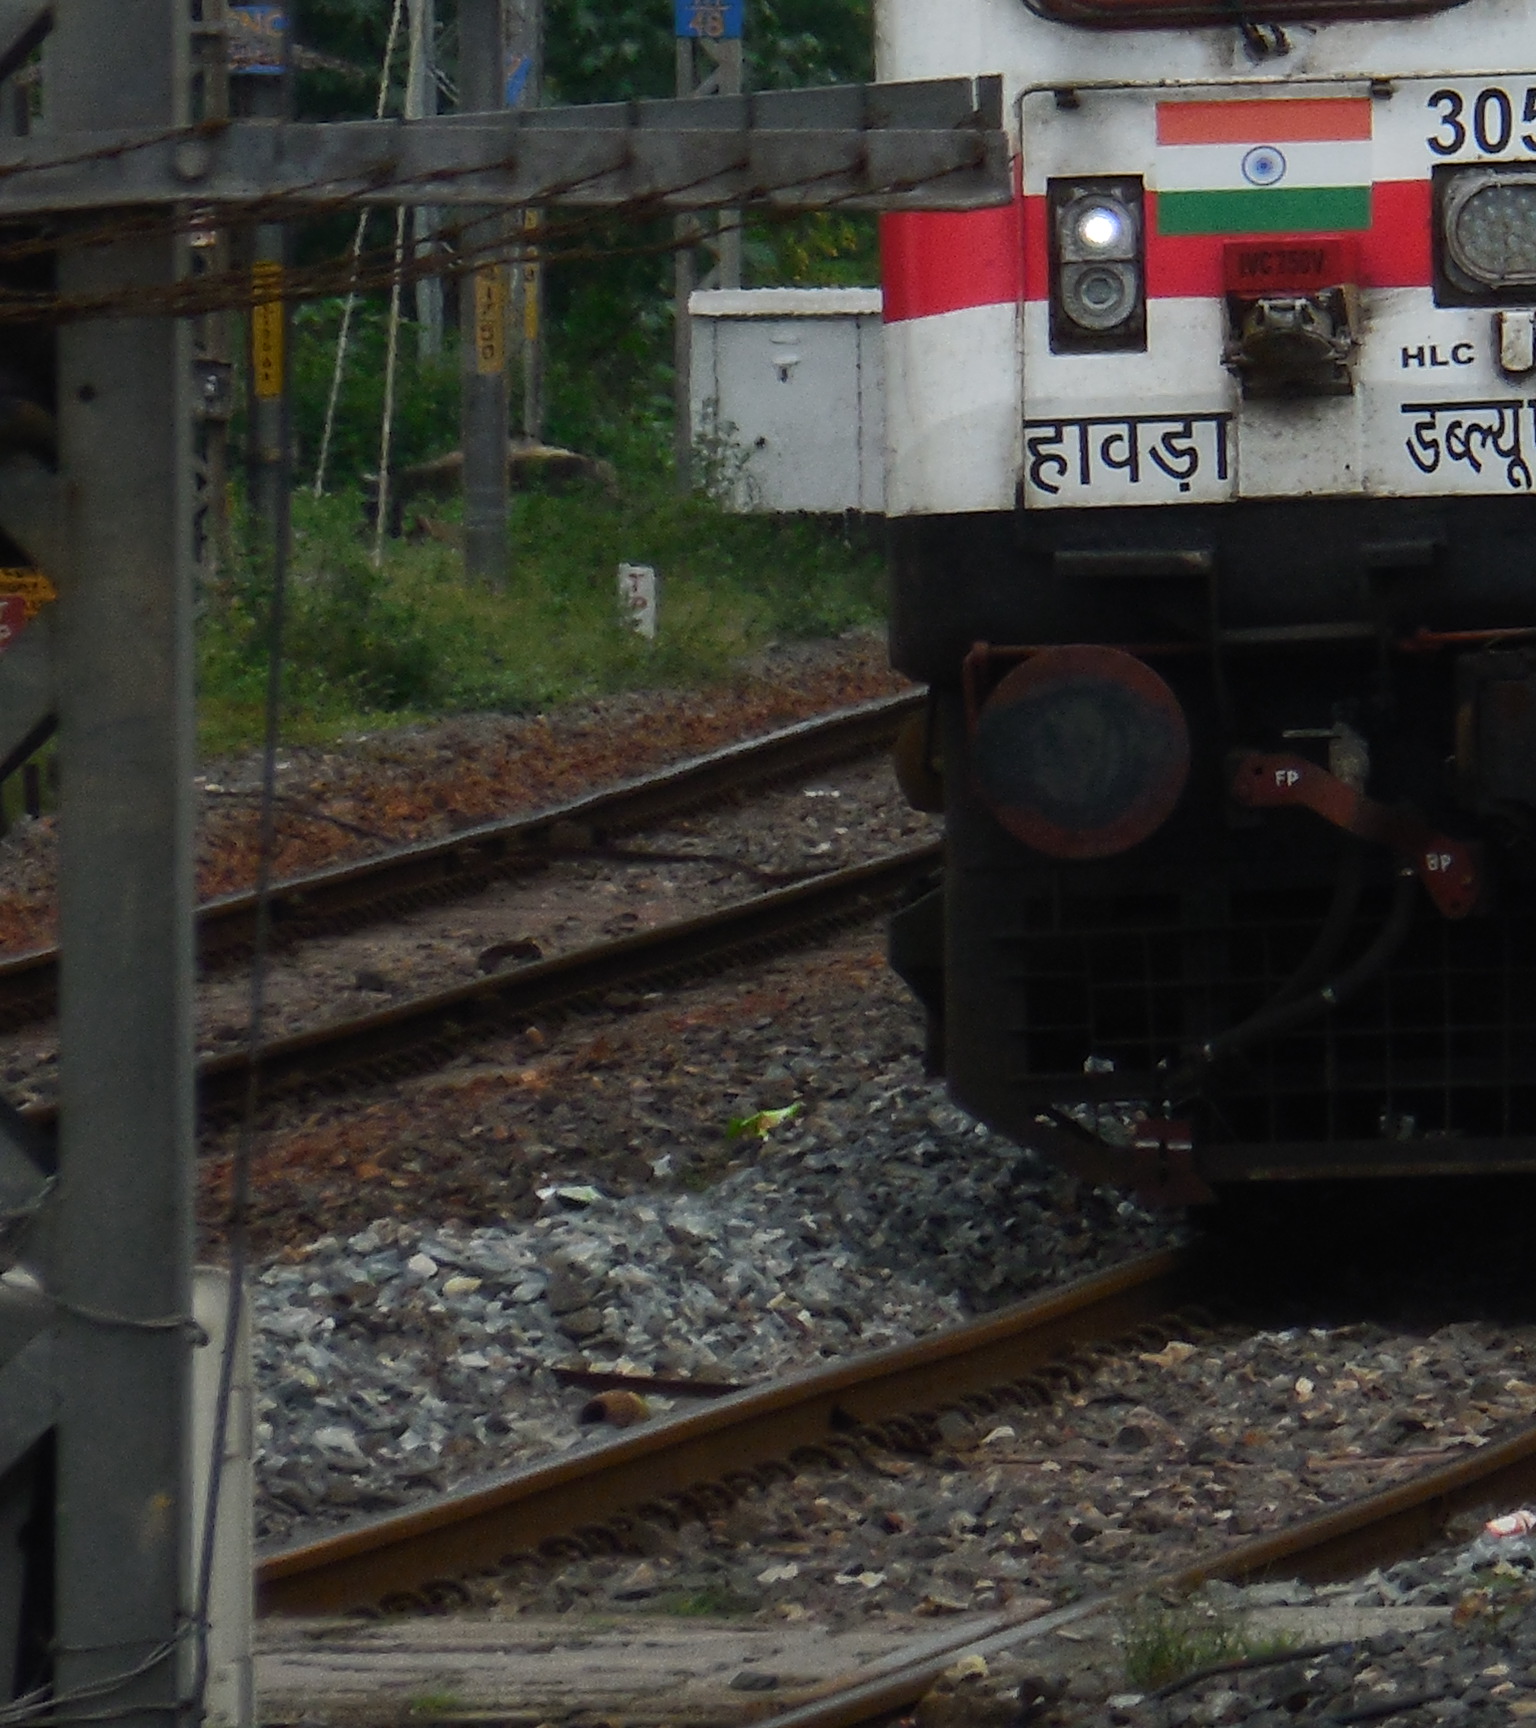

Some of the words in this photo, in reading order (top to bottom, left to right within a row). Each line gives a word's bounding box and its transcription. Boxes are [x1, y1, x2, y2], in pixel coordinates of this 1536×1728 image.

[1402, 342, 1475, 368] HLC
[1024, 412, 1234, 493] हावड़ा
[1275, 770, 1299, 787] FP
[1426, 853, 1451, 871] BP
